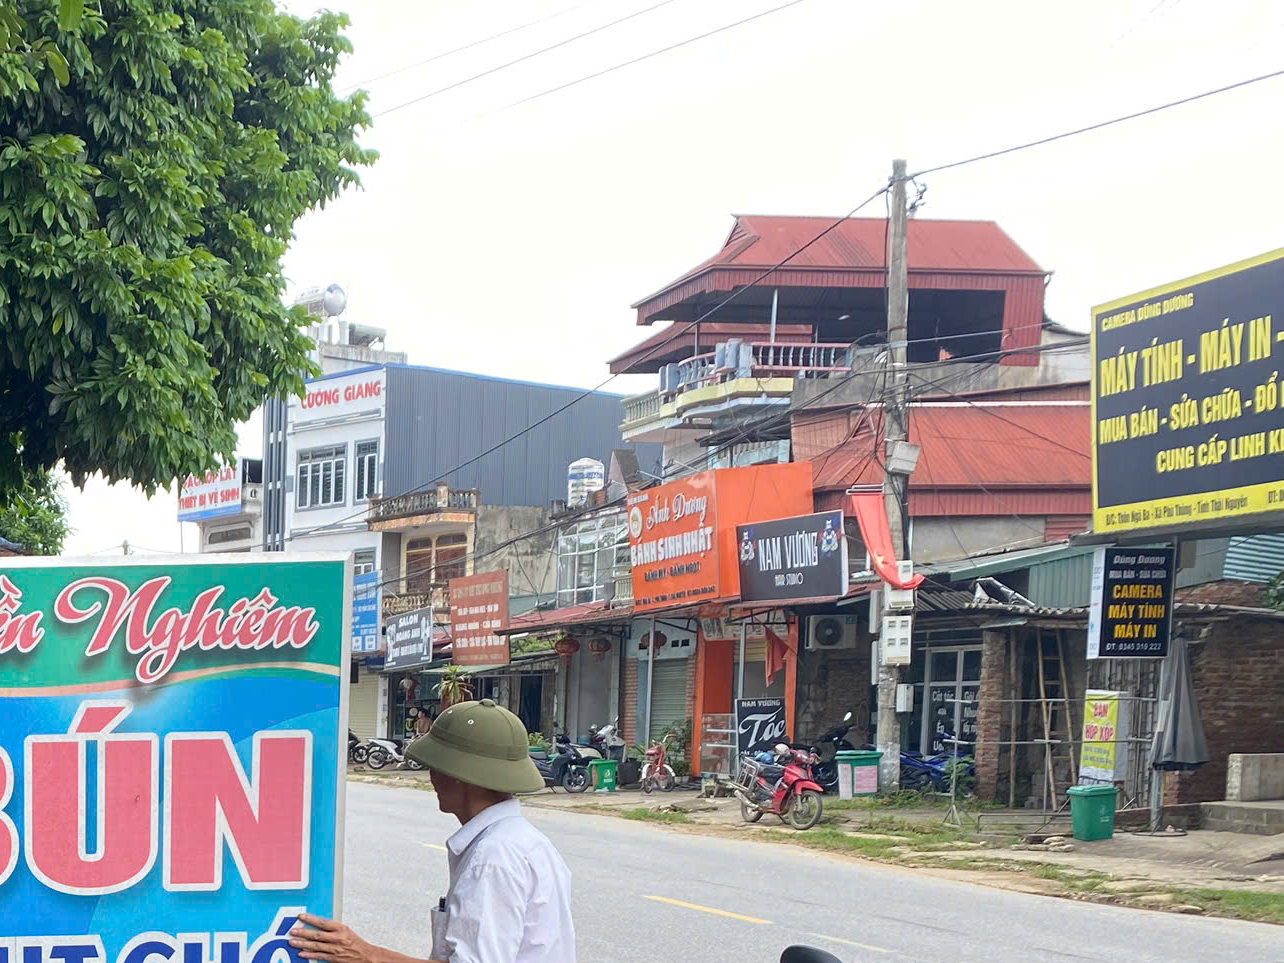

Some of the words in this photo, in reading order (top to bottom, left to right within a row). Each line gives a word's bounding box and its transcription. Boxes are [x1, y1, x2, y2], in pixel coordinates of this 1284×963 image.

[1101, 309, 1136, 332] CAMERA
[1100, 346, 1138, 397] MÁY
[1141, 337, 1183, 387] TÍNH
[1200, 317, 1244, 374] MÁY
[1249, 315, 1272, 362] IN
[344, 380, 381, 401] GIANG
[1099, 415, 1128, 445] MUA
[1130, 405, 1158, 439] BÁN
[1170, 393, 1199, 430] SỬA
[1202, 387, 1242, 424] CHỮA
[1255, 371, 1278, 413] ĐỔ
[1156, 445, 1195, 473] CUNG
[1197, 433, 1228, 467] CẤP
[1230, 432, 1266, 461] LINH
[630, 537, 656, 566] BÁNH
[658, 534, 683, 560] SINH
[684, 522, 713, 558] NHẬT
[758, 537, 782, 571] NAM
[784, 530, 818, 569] VƯƠNG
[1112, 584, 1163, 599] CAMERA
[399, 614, 419, 628] SALON
[1108, 602, 1135, 619] MÁY
[1138, 602, 1165, 619] TÍNH
[54, 576, 319, 684] Nghiêm
[1114, 621, 1141, 638] MÁY
[1143, 624, 1157, 638] IN
[741, 700, 756, 708] NAM
[738, 707, 786, 748] Tóc
